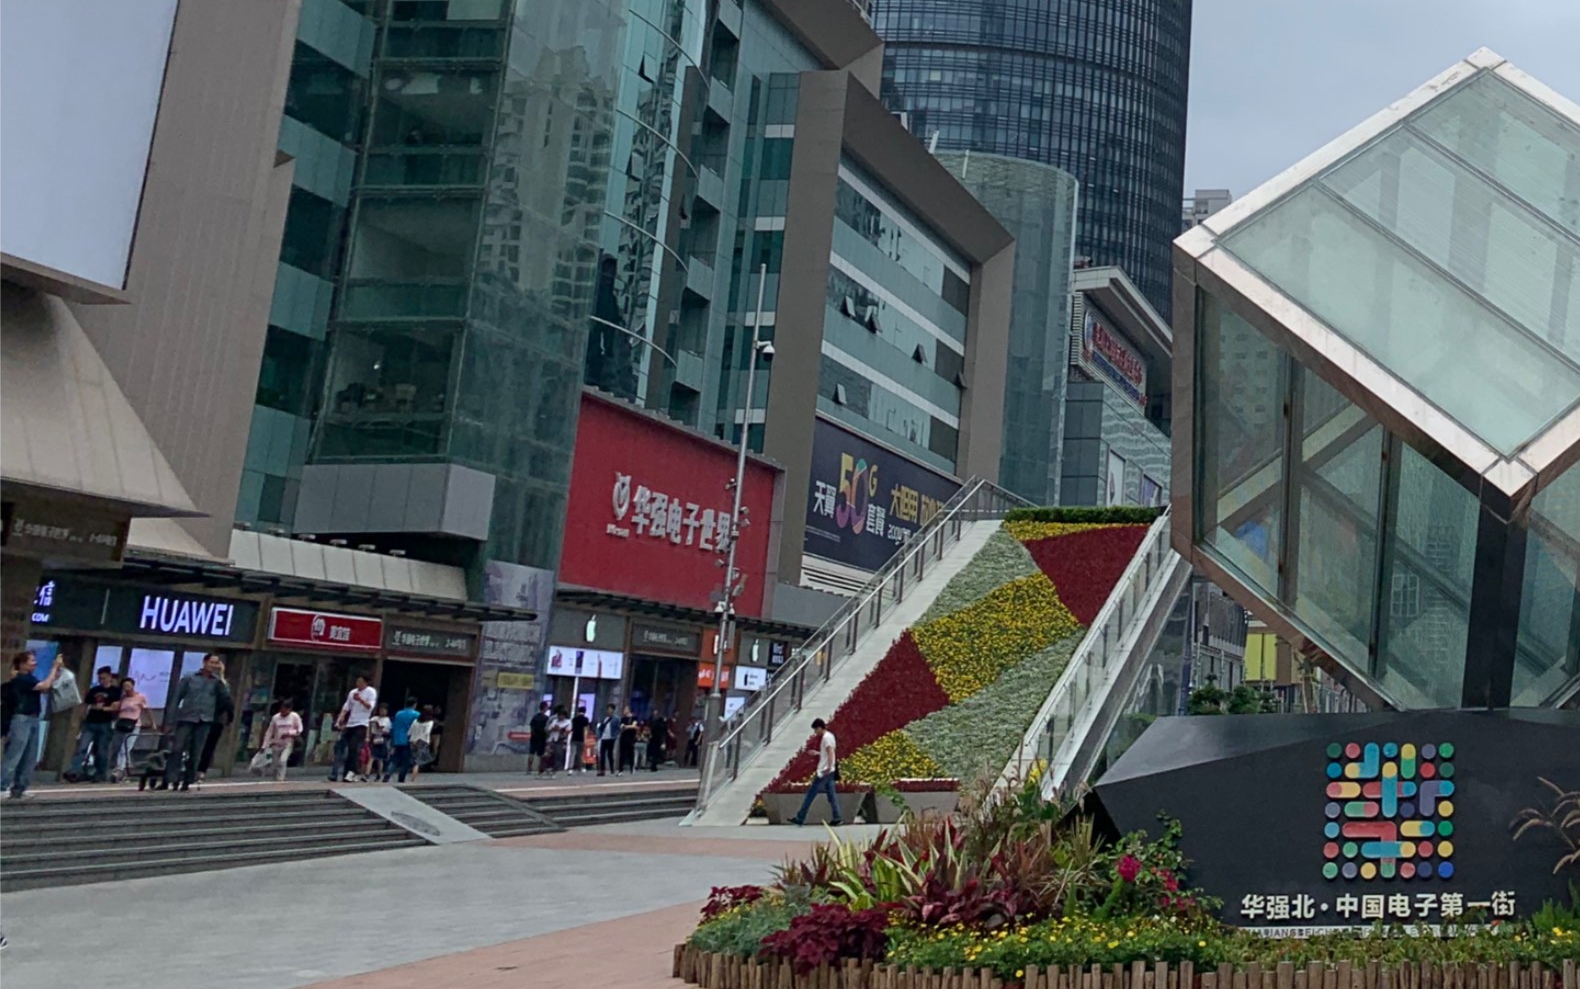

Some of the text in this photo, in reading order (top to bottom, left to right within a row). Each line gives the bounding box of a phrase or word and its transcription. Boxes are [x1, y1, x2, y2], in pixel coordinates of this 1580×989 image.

[631, 484, 731, 554] 华强电子世界
[140, 595, 234, 636] HUAWEI
